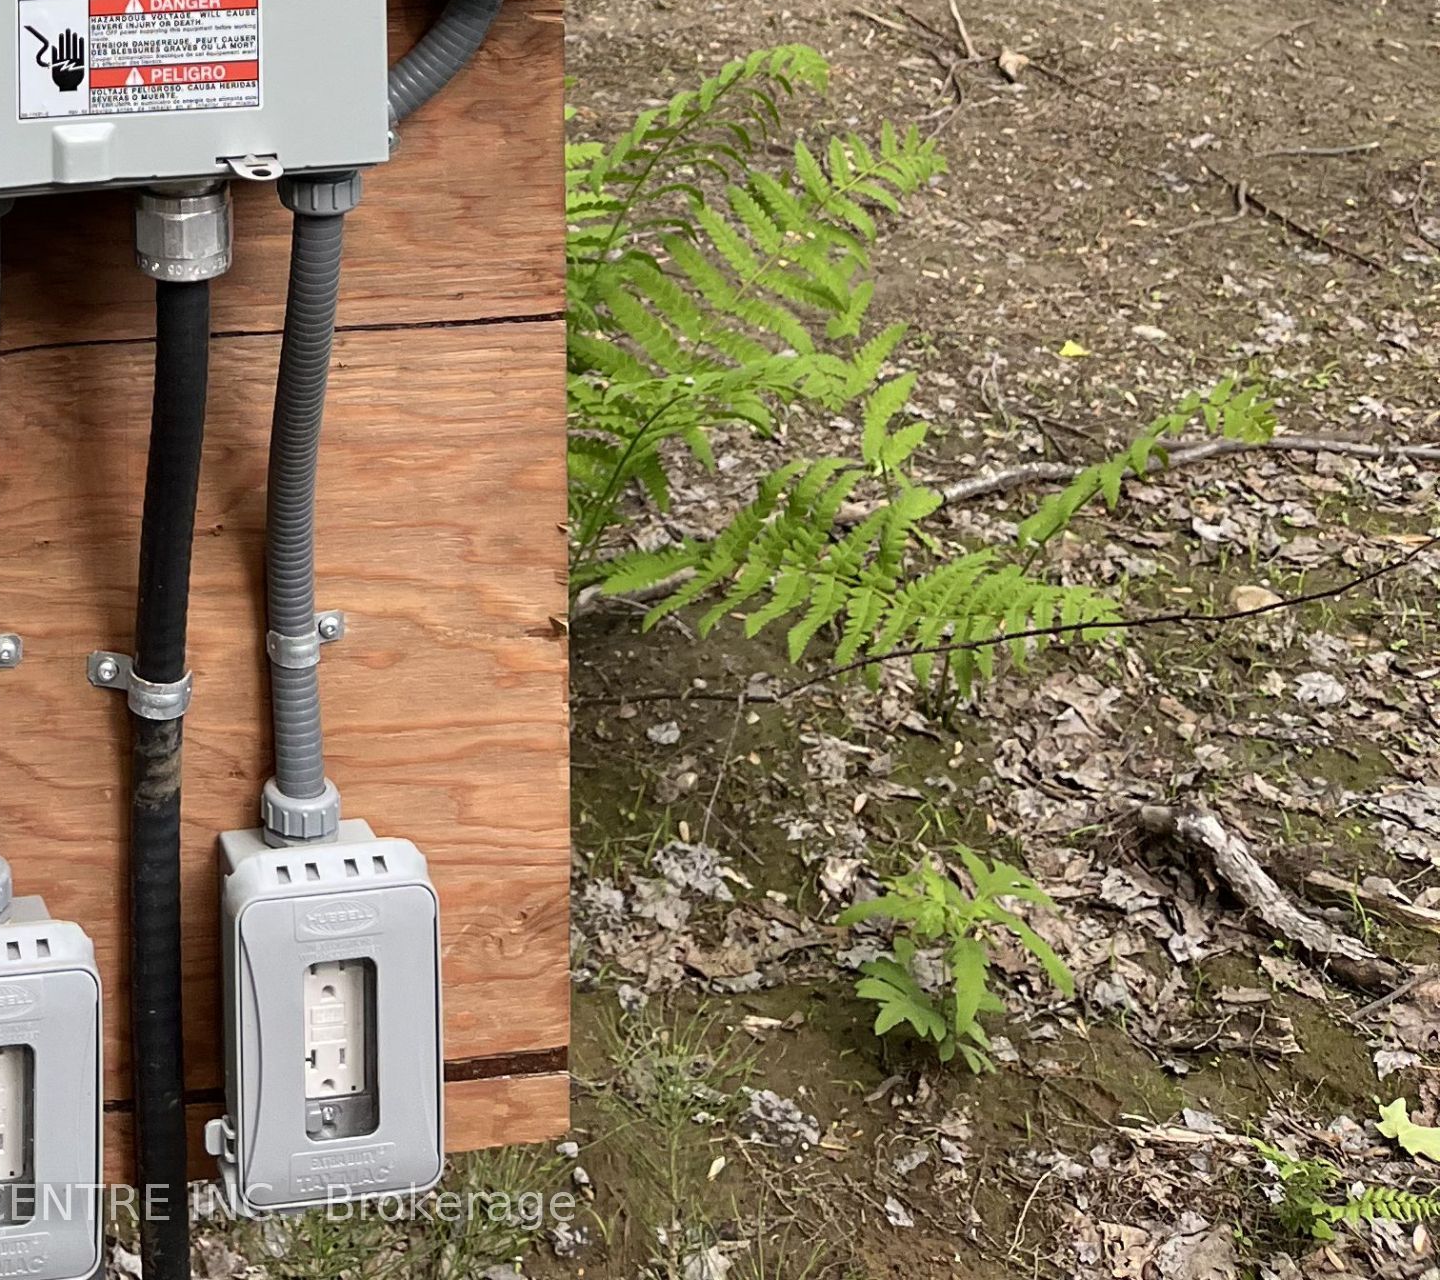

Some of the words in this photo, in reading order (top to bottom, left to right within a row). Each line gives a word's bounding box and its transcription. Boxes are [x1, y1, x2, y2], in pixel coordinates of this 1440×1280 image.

[91, 14, 146, 23] HAZARDOUS
[200, 10, 221, 18] WILL
[226, 9, 256, 17] CAUSE
[125, 21, 156, 29] INJURY
[91, 41, 129, 49] TENSION
[110, 46, 161, 55] BLESSURES
[163, 44, 198, 53] GRAVES
[150, 65, 226, 83] PELIGRO
[91, 87, 128, 96] VOLTAJE
[219, 81, 257, 90] HERIDAS
[91, 95, 130, 103] SEVERAS
